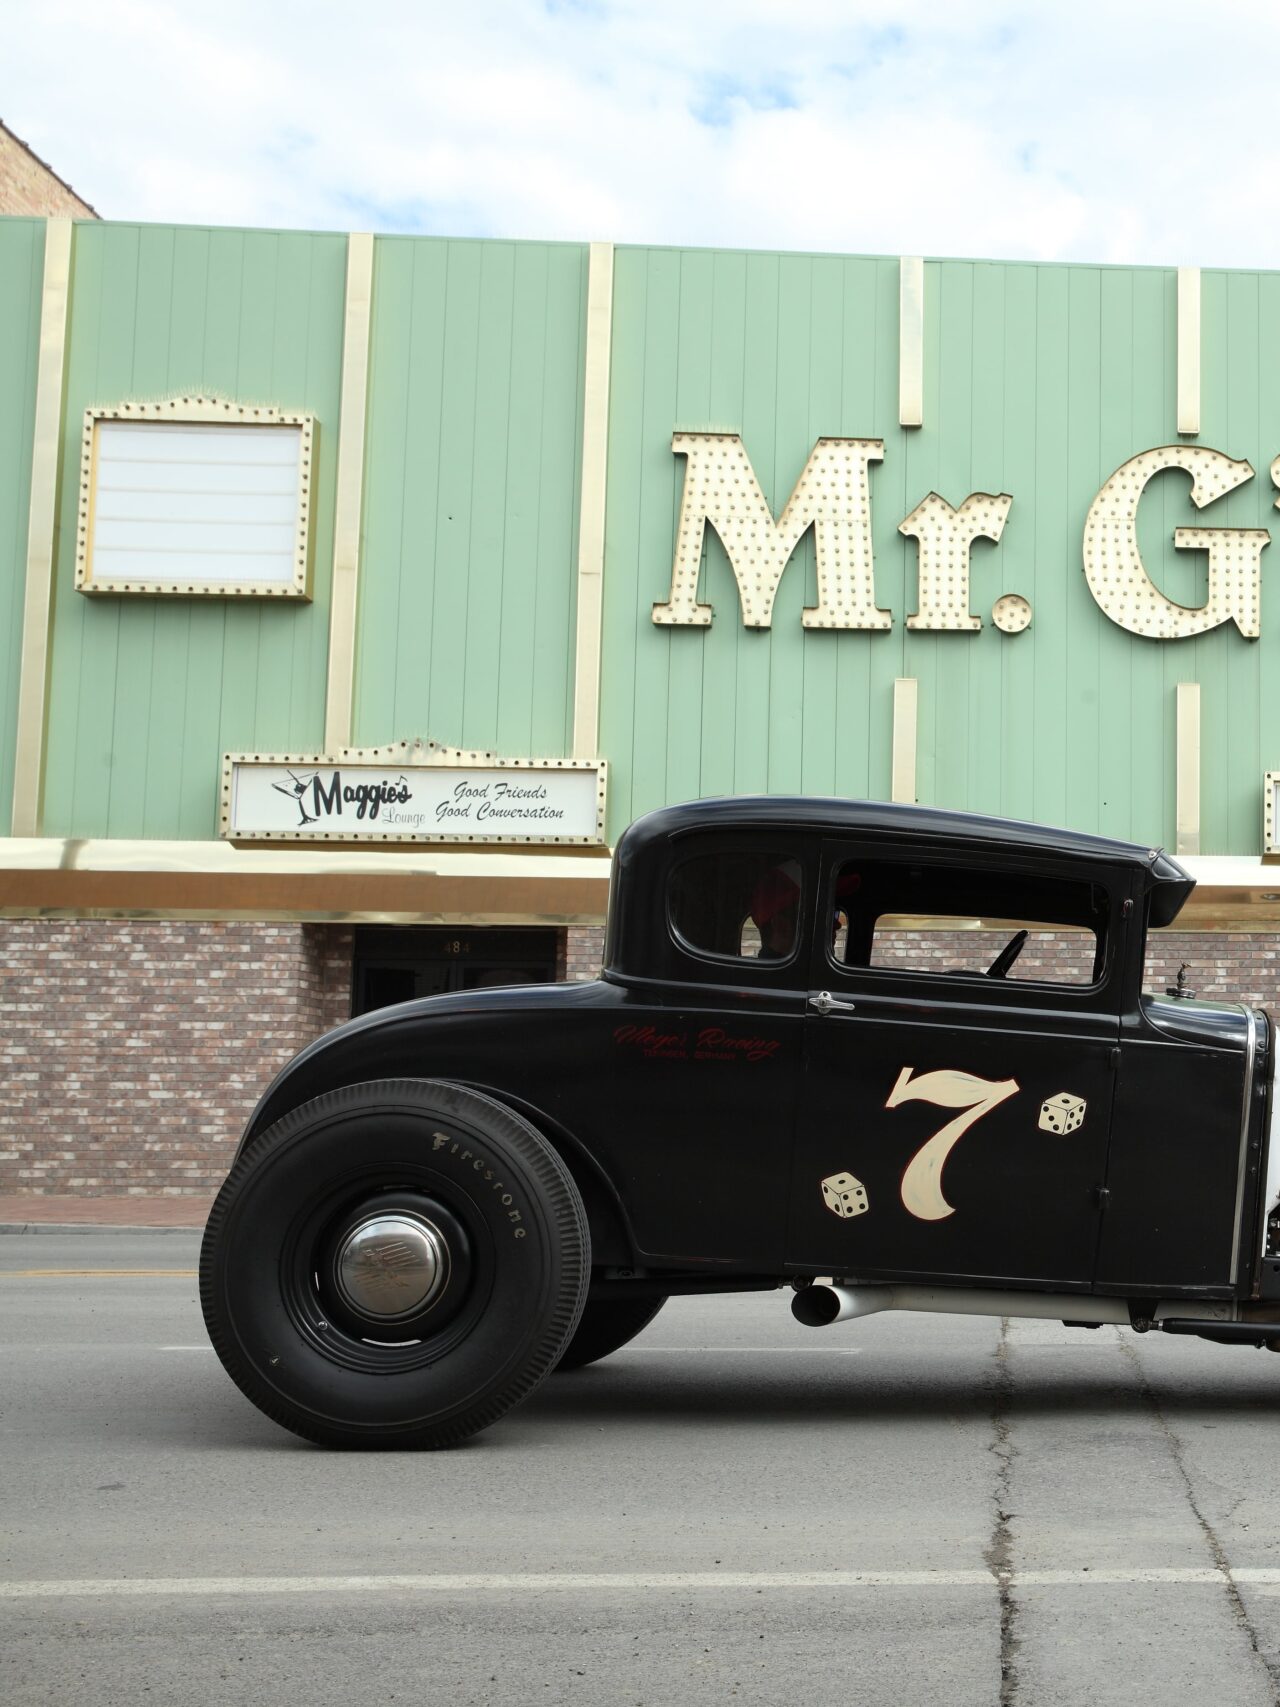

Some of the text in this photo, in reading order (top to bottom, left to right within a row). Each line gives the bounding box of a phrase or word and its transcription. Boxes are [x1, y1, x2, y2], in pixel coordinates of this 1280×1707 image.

[652, 432, 1033, 634] Mr.
[313, 771, 412, 820] Maggie's
[435, 800, 564, 822] Good Conversation
[453, 780, 547, 803] Good Friends
[382, 805, 426, 829] Lounge
[697, 1027, 782, 1062] Racing
[885, 1066, 1020, 1221] 7
[431, 1131, 527, 1239] Firestone
